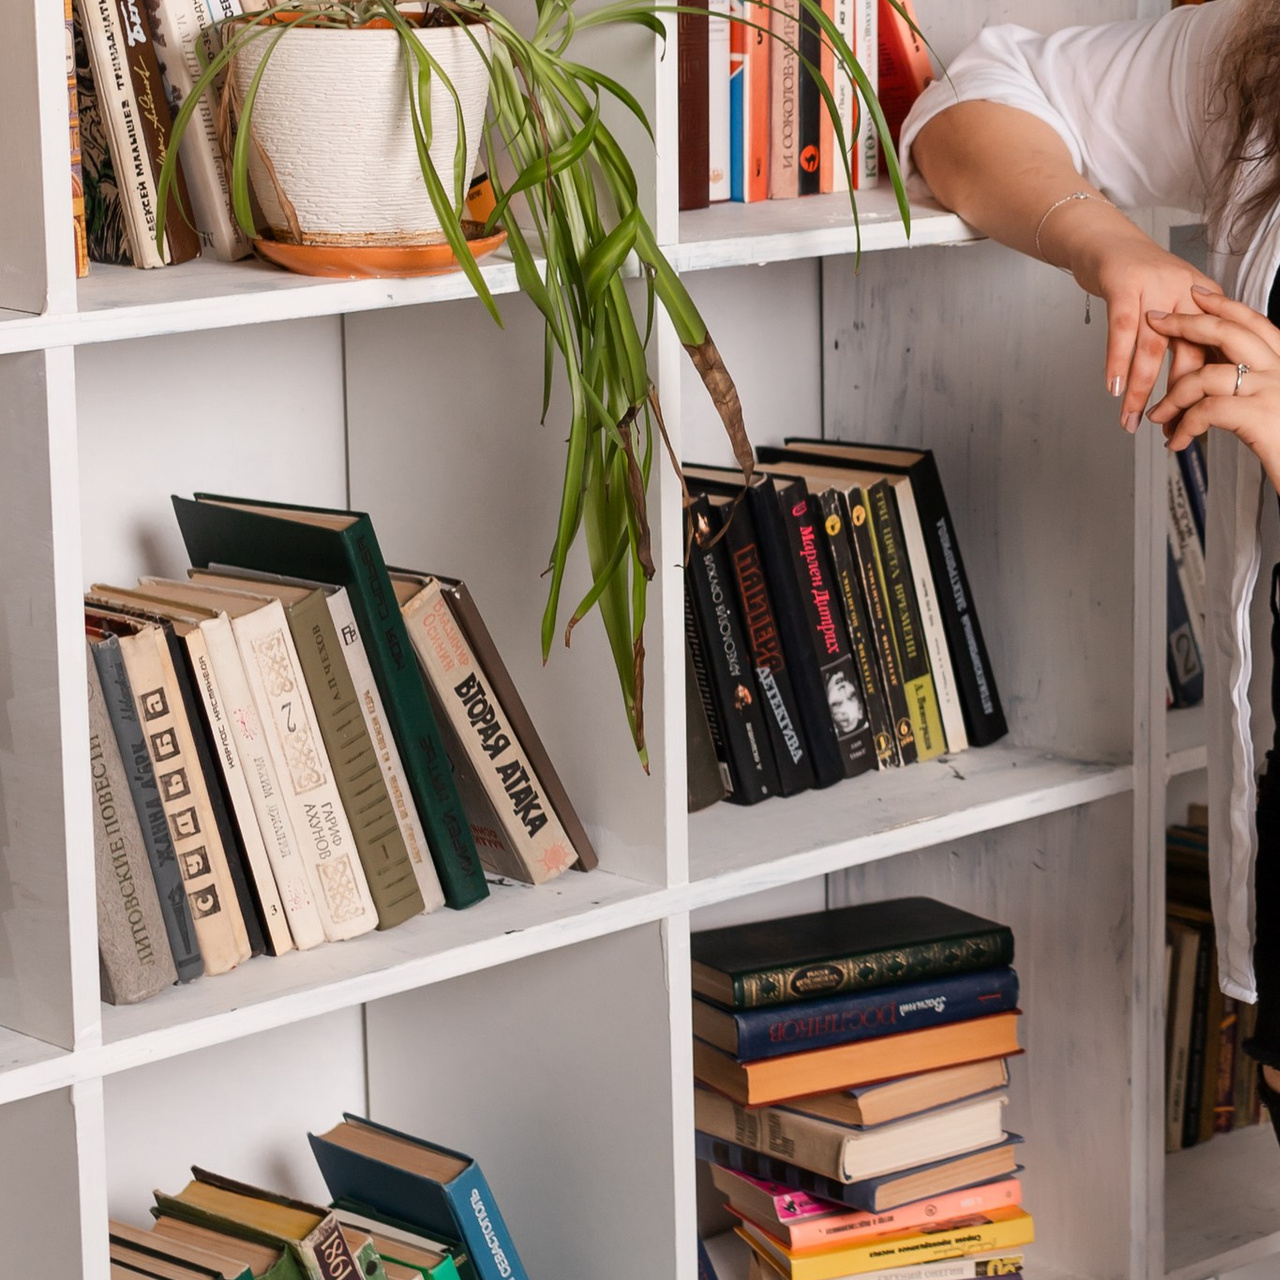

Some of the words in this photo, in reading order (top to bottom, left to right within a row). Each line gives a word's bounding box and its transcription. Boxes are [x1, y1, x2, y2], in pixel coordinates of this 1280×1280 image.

[121, 98, 145, 181] МАЛЫШЕВ
[799, 524, 823, 591] Марлен
[810, 587, 840, 655] Дитрих
[1175, 632, 1197, 674] 2
[281, 700, 298, 734] 2
[453, 671, 512, 762] ВТОРАЯ
[495, 757, 550, 840] АТАКА
[143, 790, 176, 868] ЖАННА
[303, 803, 333, 862] АХУНОВ
[320, 801, 344, 848] ГАРИФ
[106, 830, 155, 965] ЛИТОВСКИЕ
[469, 1187, 511, 1279] СЕВАСТОПОЛЬ
